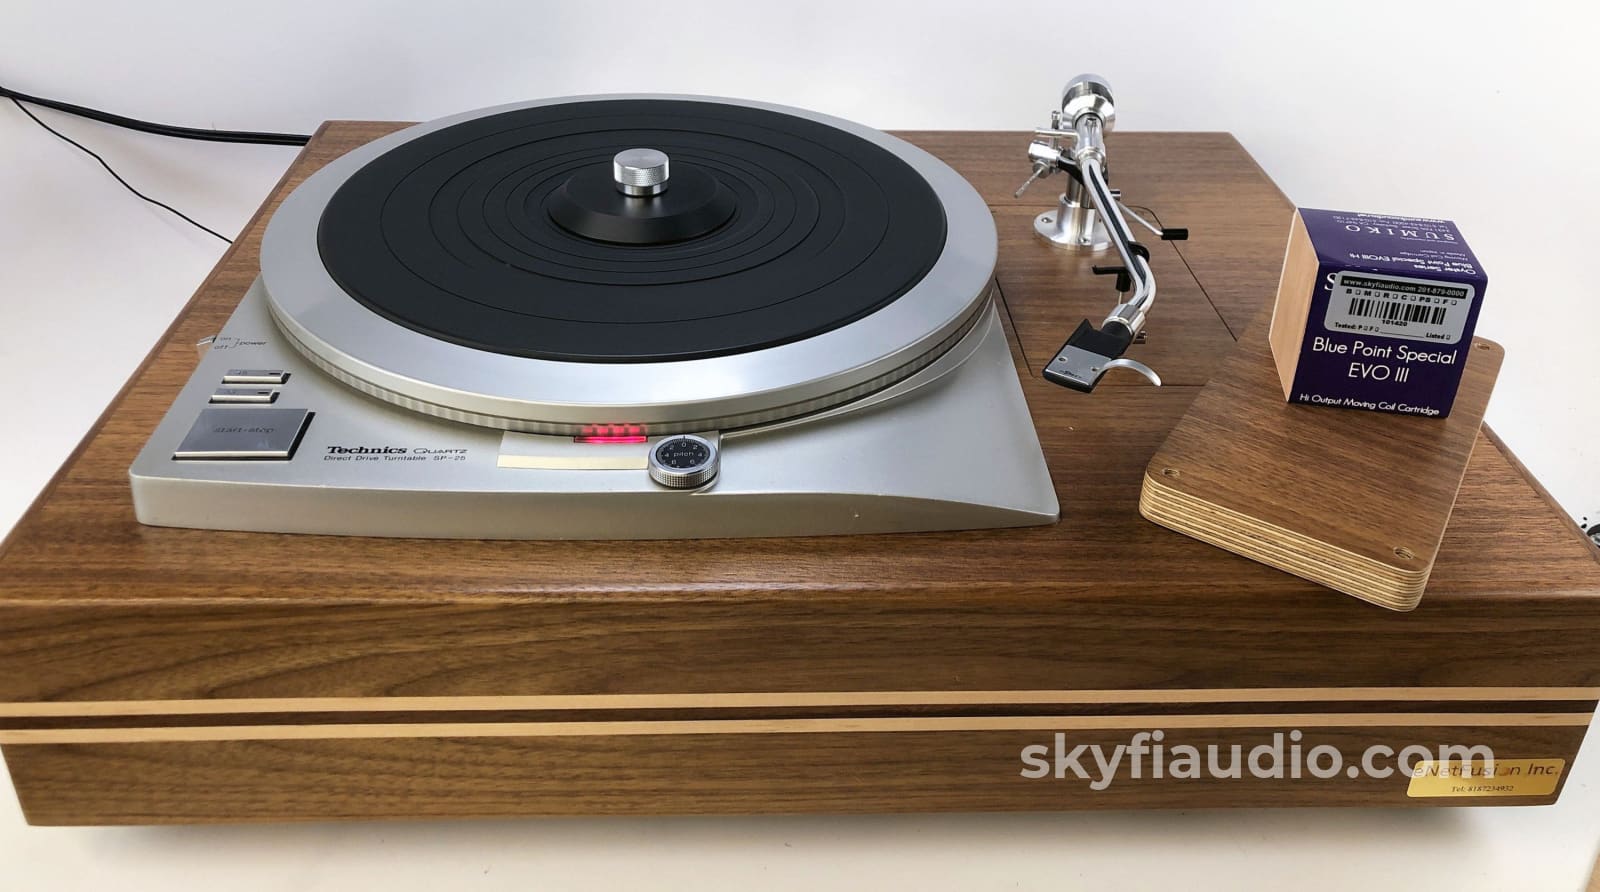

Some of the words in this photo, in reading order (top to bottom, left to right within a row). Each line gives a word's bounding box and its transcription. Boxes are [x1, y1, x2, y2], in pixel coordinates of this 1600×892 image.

[1345, 224, 1455, 241] SUMIKO
[1391, 256, 1425, 265] Special
[1444, 267, 1476, 275] Oyster
[1343, 279, 1416, 292] www.skyfiaudio.com
[1334, 322, 1356, 330] Tested:
[1426, 332, 1445, 340] Listed
[1312, 336, 1348, 354] Blue
[1352, 341, 1392, 359] Point
[1396, 345, 1458, 365] Special
[1348, 362, 1391, 381] EVO
[1394, 367, 1410, 383] III
[1300, 393, 1310, 402] Hi
[1311, 394, 1342, 405] Output
[1343, 398, 1376, 410] Moving
[1378, 401, 1396, 411] Coil
[1398, 403, 1440, 416] Cartridge
[327, 446, 407, 455] Technics
[1527, 763, 1559, 777] Inc.
